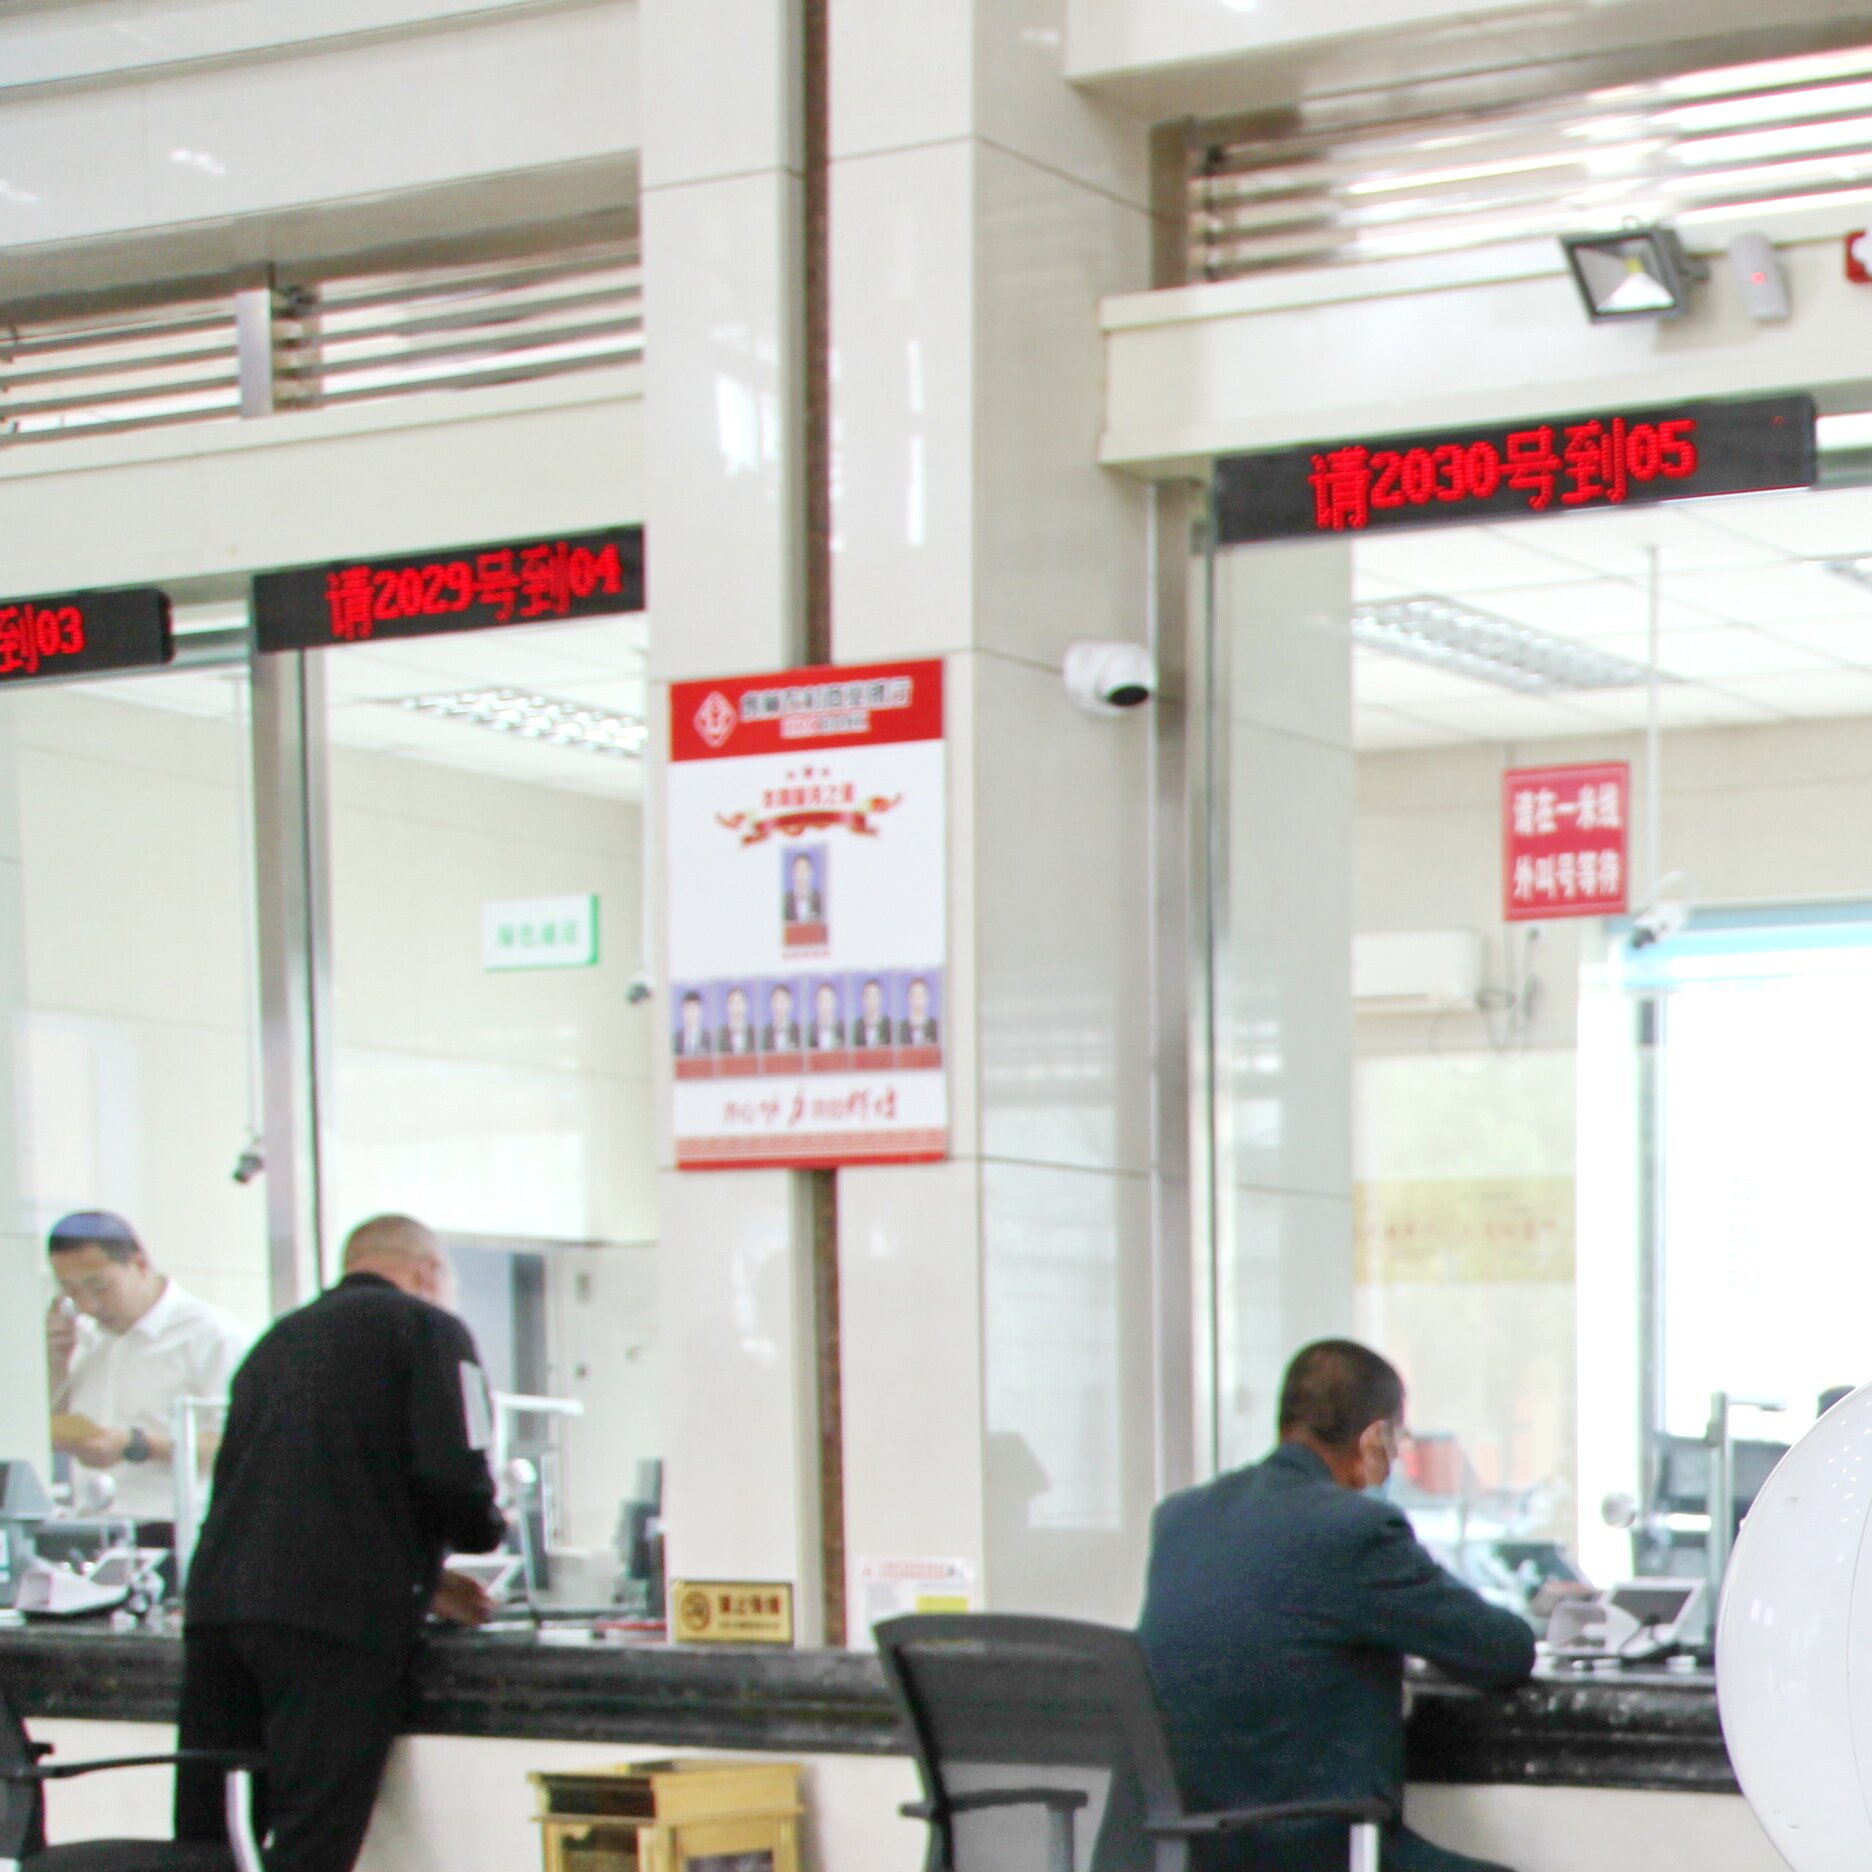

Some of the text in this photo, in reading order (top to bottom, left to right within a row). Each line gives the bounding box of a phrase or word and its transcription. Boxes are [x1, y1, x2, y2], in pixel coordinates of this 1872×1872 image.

[1308, 417, 1698, 531] 请2030号到05
[326, 541, 623, 640] 请2029号到04
[1513, 848, 1620, 901] 外叫号等待
